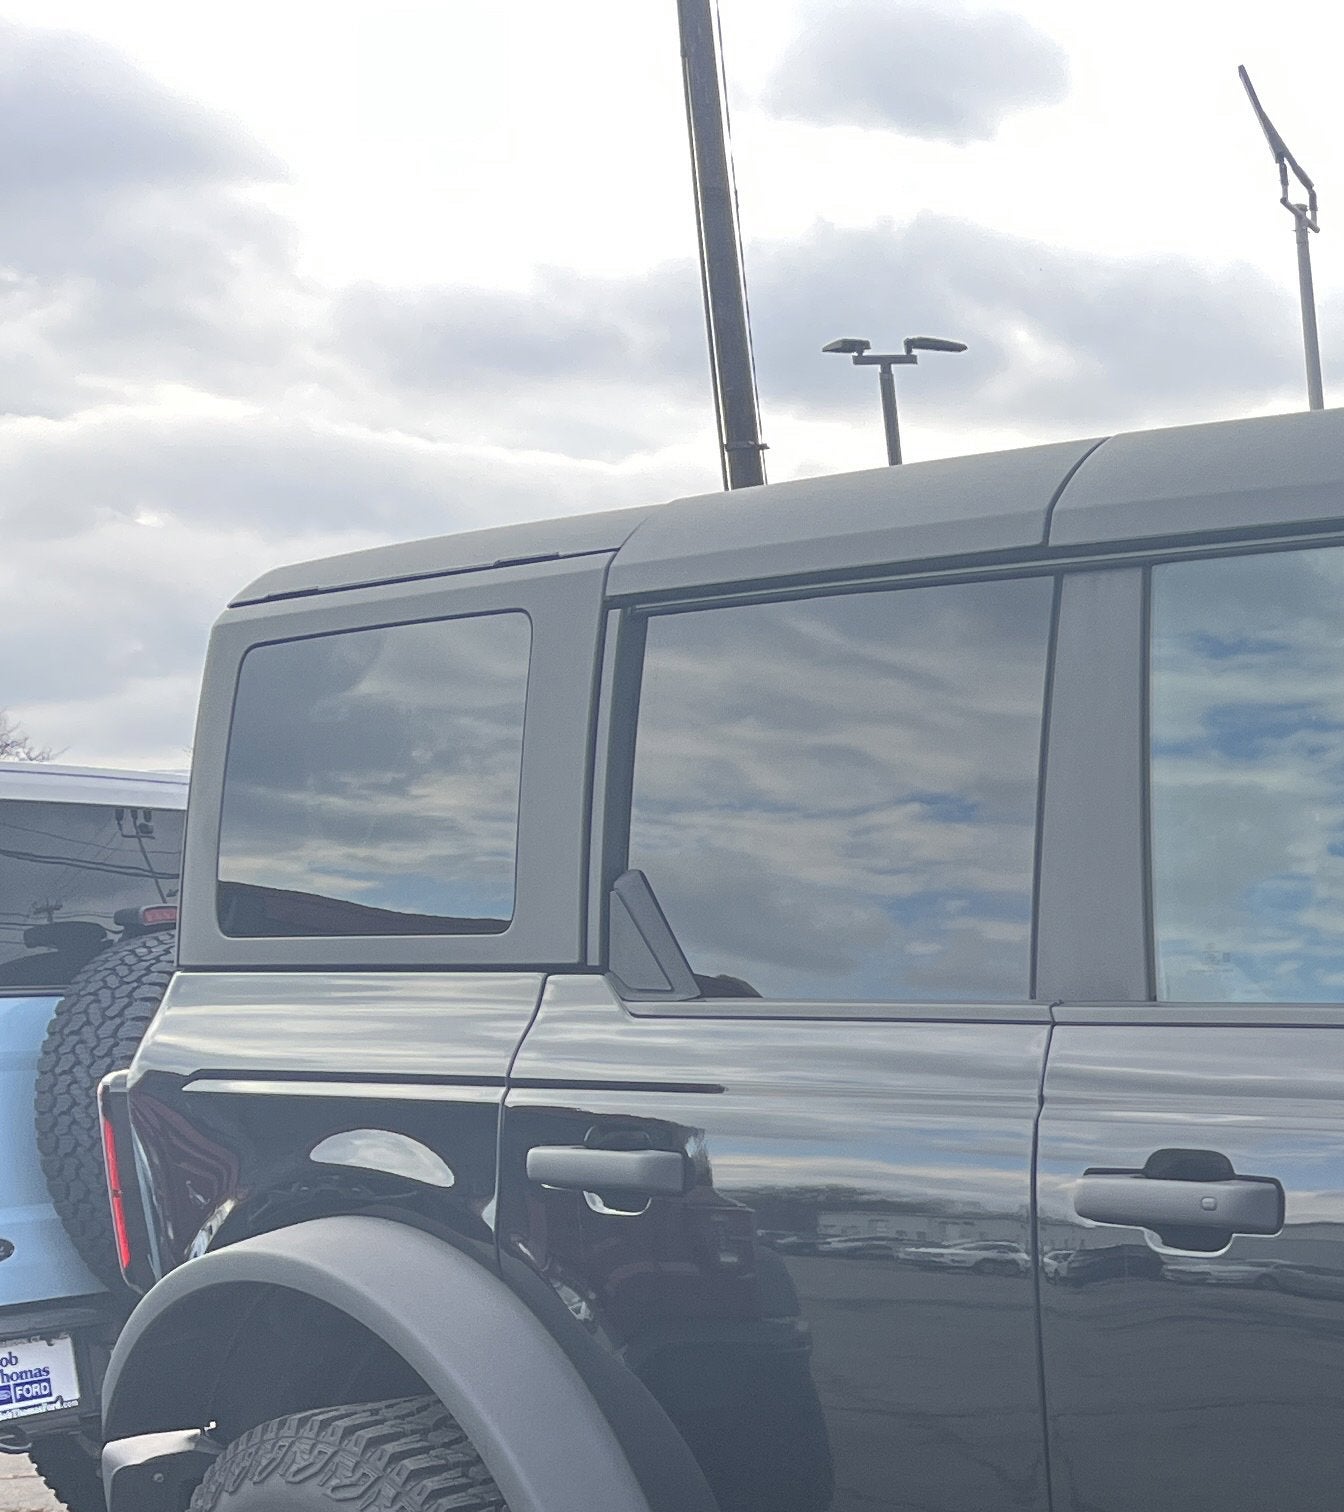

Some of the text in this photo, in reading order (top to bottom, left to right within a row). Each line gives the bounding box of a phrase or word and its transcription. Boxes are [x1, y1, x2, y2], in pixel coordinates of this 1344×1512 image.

[0, 1351, 18, 1367] ob
[0, 1366, 50, 1384] homas
[15, 1382, 50, 1400] FORD
